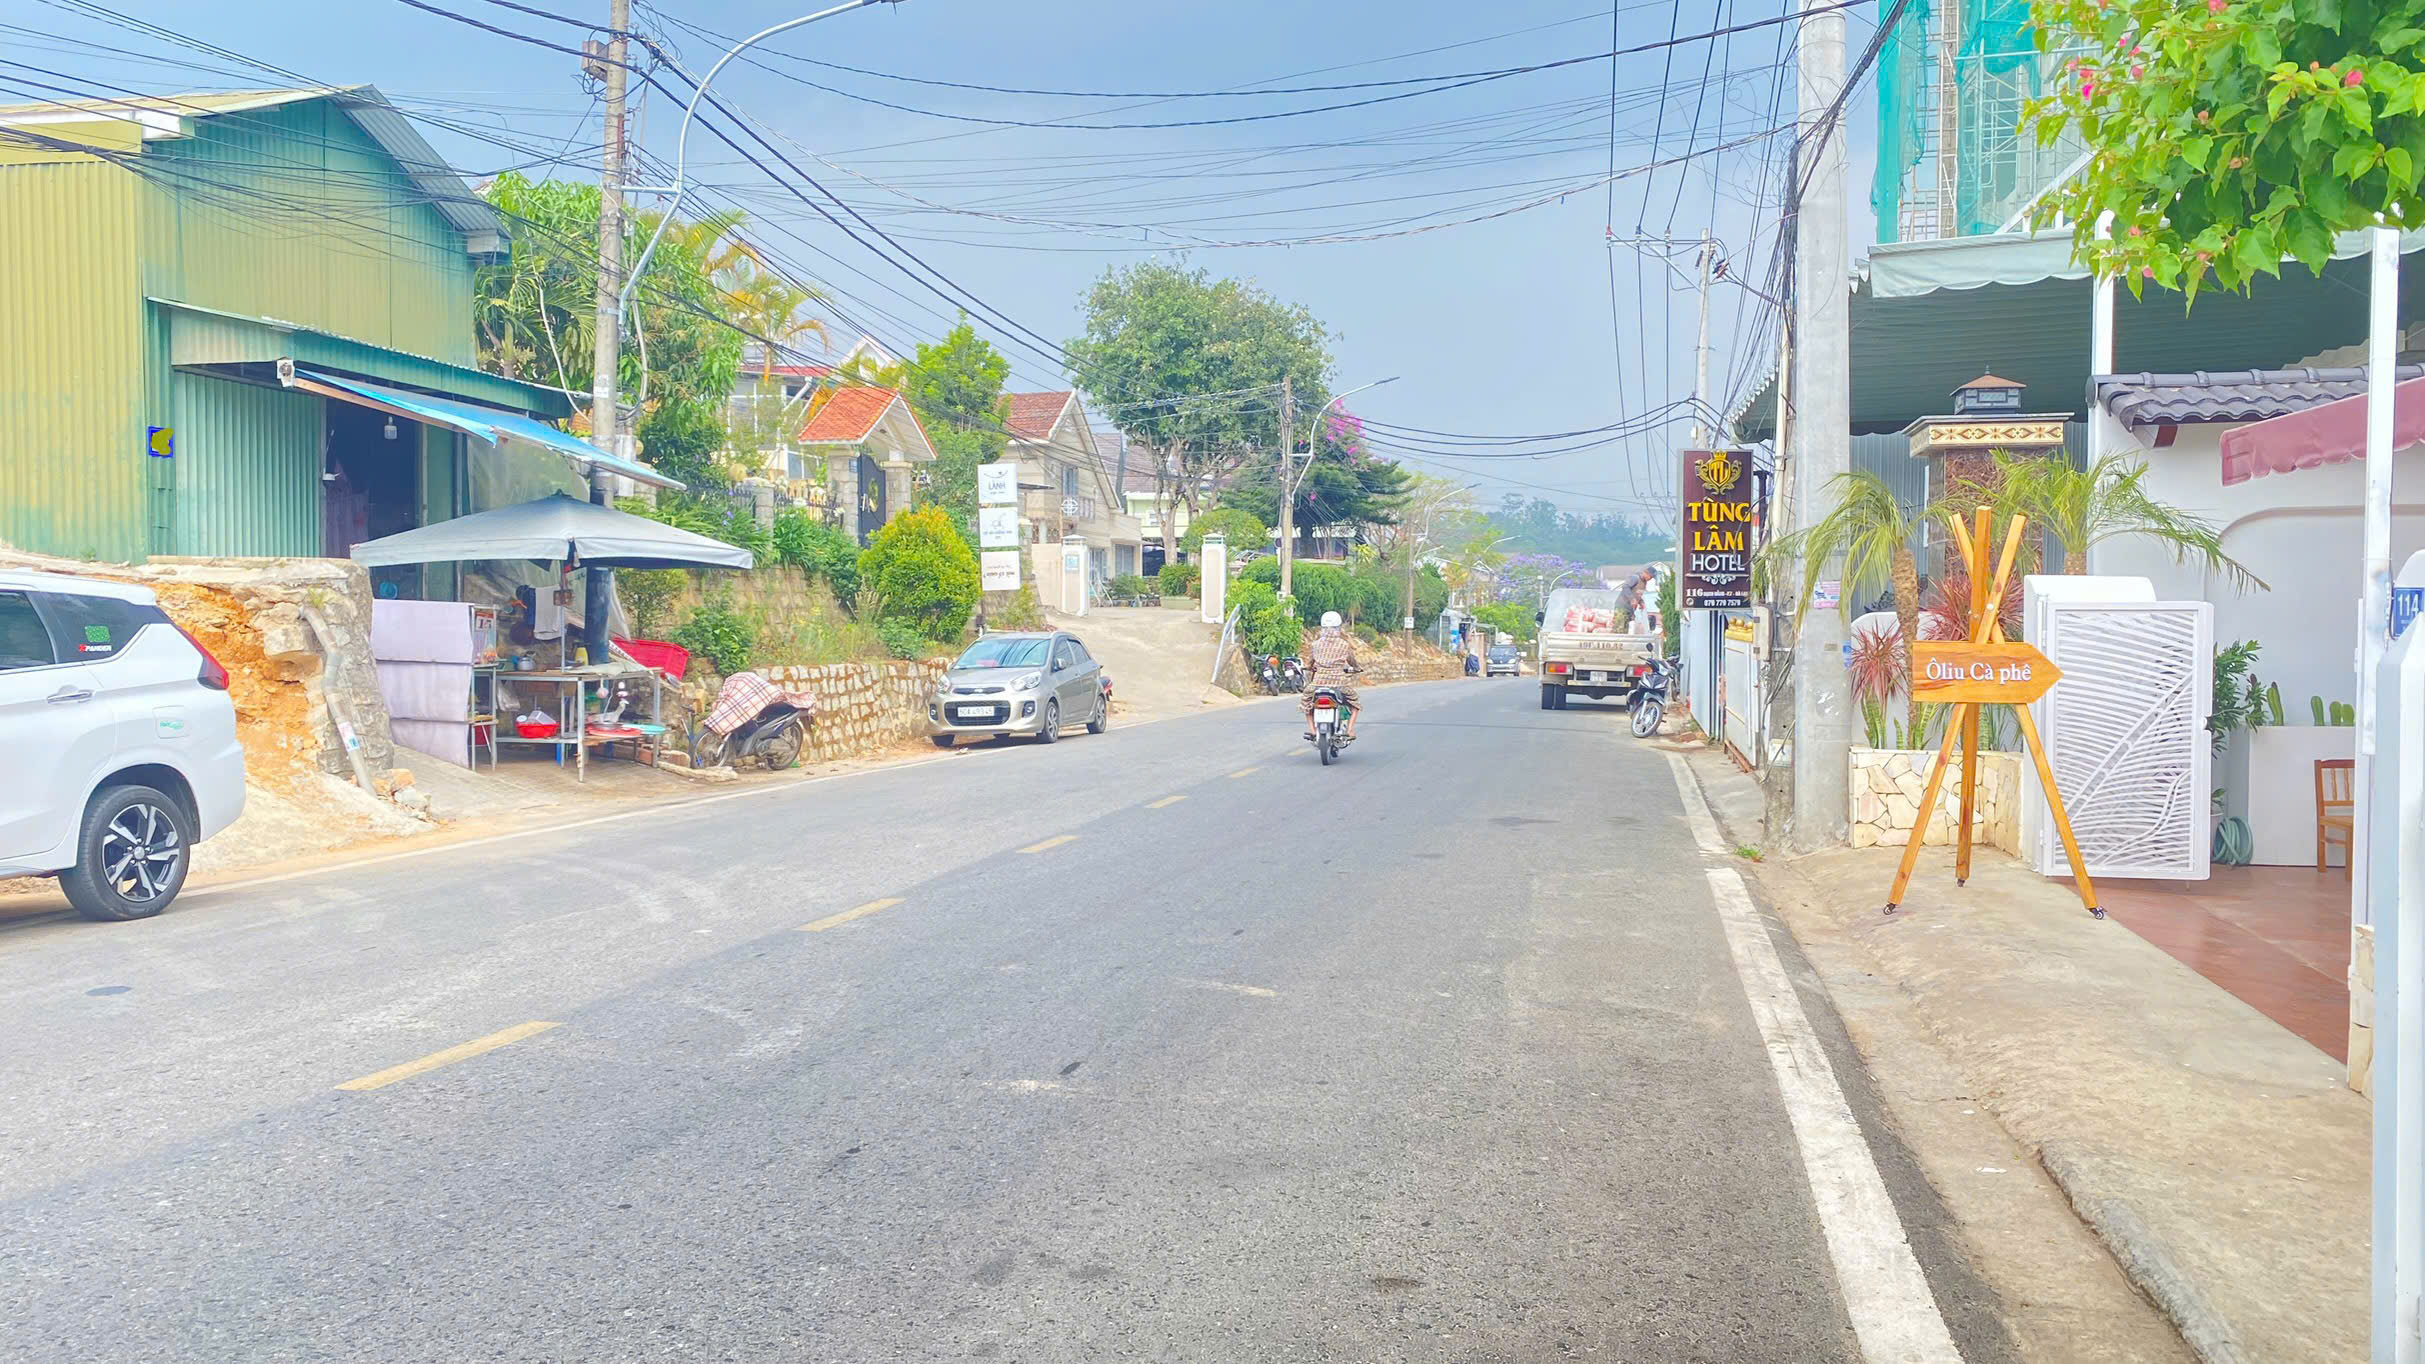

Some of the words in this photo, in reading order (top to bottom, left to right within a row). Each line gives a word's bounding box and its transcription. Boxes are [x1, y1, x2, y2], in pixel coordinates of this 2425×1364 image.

[1688, 497, 1751, 522] TÙNG
[1694, 525, 1744, 550] LÂM
[1692, 554, 1745, 571] HOTEL
[1686, 588, 1703, 596] 116
[2398, 593, 2419, 616] 114
[1926, 657, 1964, 680] Ôliu
[1970, 662, 1994, 680] Cà
[1999, 663, 2032, 684] phê
